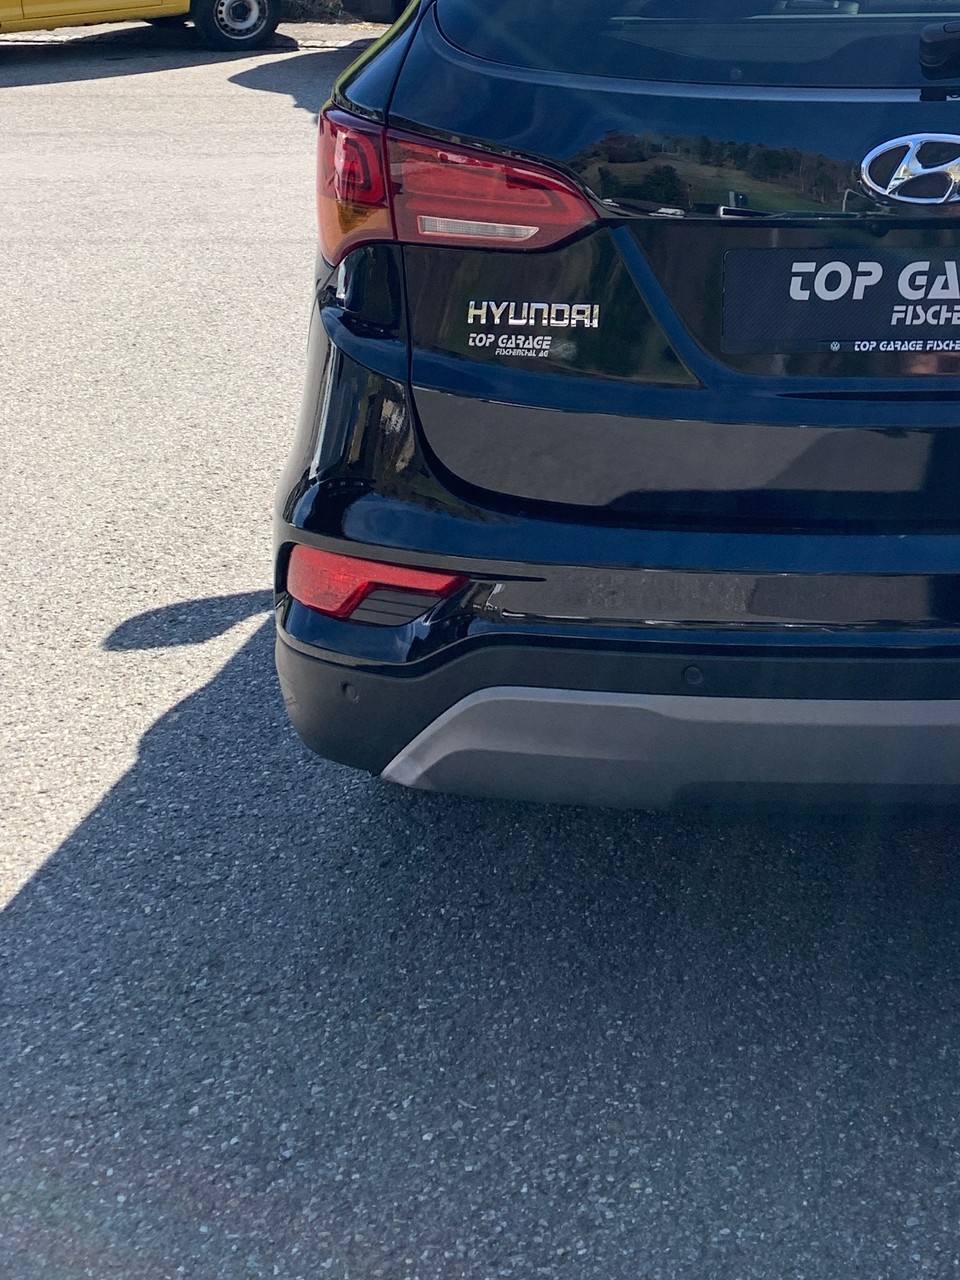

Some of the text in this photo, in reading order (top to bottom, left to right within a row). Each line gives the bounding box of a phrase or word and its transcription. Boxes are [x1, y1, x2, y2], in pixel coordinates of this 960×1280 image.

[788, 260, 884, 302] TOP
[467, 300, 600, 328] HYUNDAI
[468, 333, 553, 350] TOP GARAGE
[854, 341, 877, 352] TOP
[879, 340, 923, 351] GARAGE
[495, 348, 549, 357] FISCHENTHAL AG
